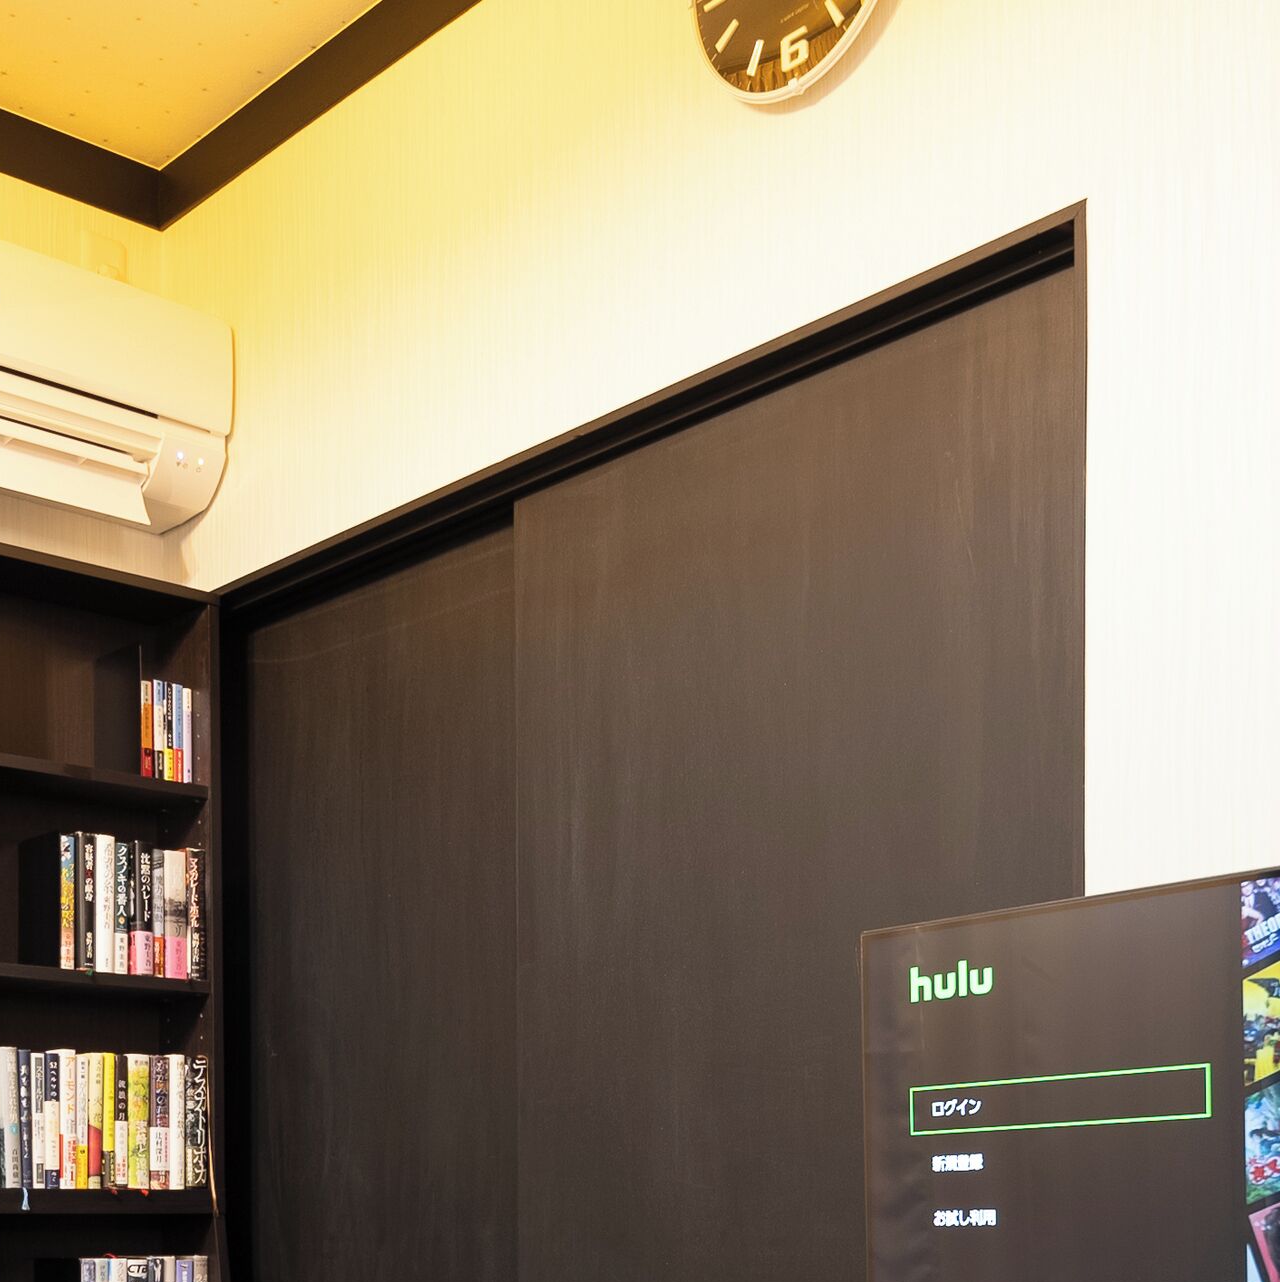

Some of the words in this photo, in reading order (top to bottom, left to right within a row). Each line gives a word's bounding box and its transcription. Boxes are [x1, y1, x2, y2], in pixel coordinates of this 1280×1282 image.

[780, 25, 809, 72] 6
[116, 845, 128, 917] クスノキの番人
[140, 852, 151, 922] 沈黙のパレード
[909, 959, 993, 1003] hulu
[65, 1055, 77, 1113] アーモンド
[118, 1079, 127, 1121] 流浪の月
[931, 1099, 982, 1118] ログイン
[933, 1208, 997, 1227] お試し利用
